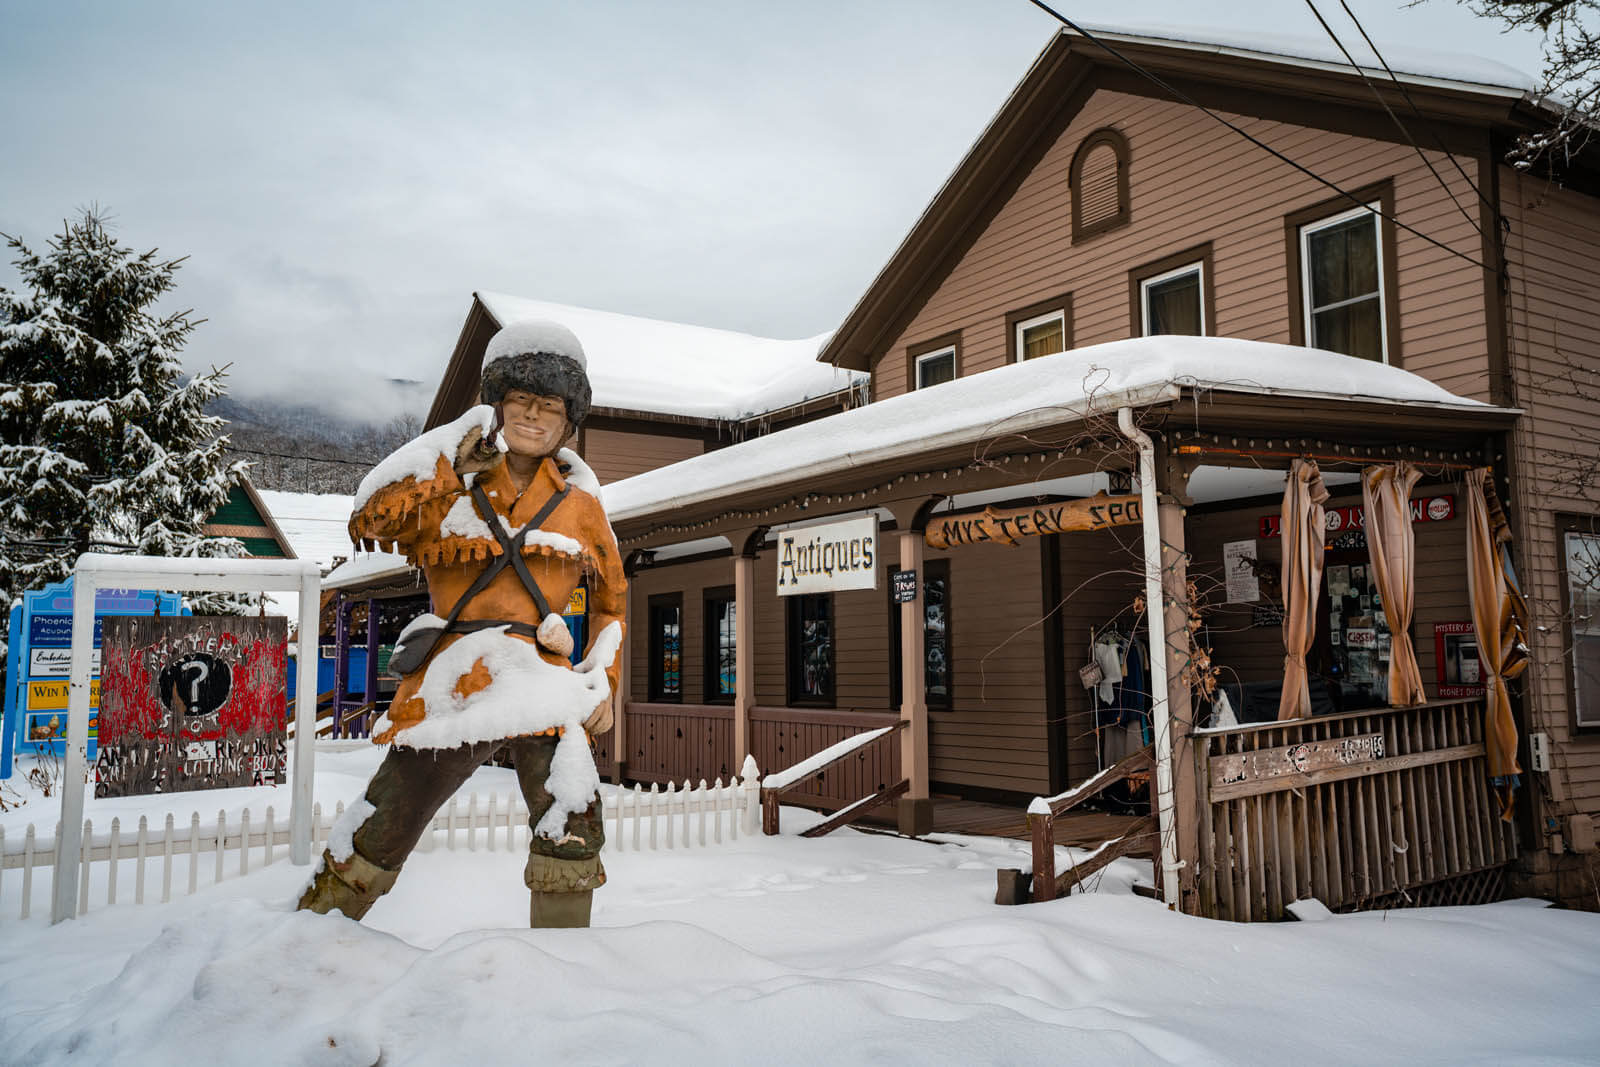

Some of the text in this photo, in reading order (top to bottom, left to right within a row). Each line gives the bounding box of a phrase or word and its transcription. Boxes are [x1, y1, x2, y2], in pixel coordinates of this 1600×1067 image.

[943, 501, 1141, 546] MYSTERY SPO
[779, 536, 873, 586] Antiques
[34, 616, 72, 625] Phoenic
[40, 627, 72, 635] Acupun
[159, 713, 219, 732] SOT
